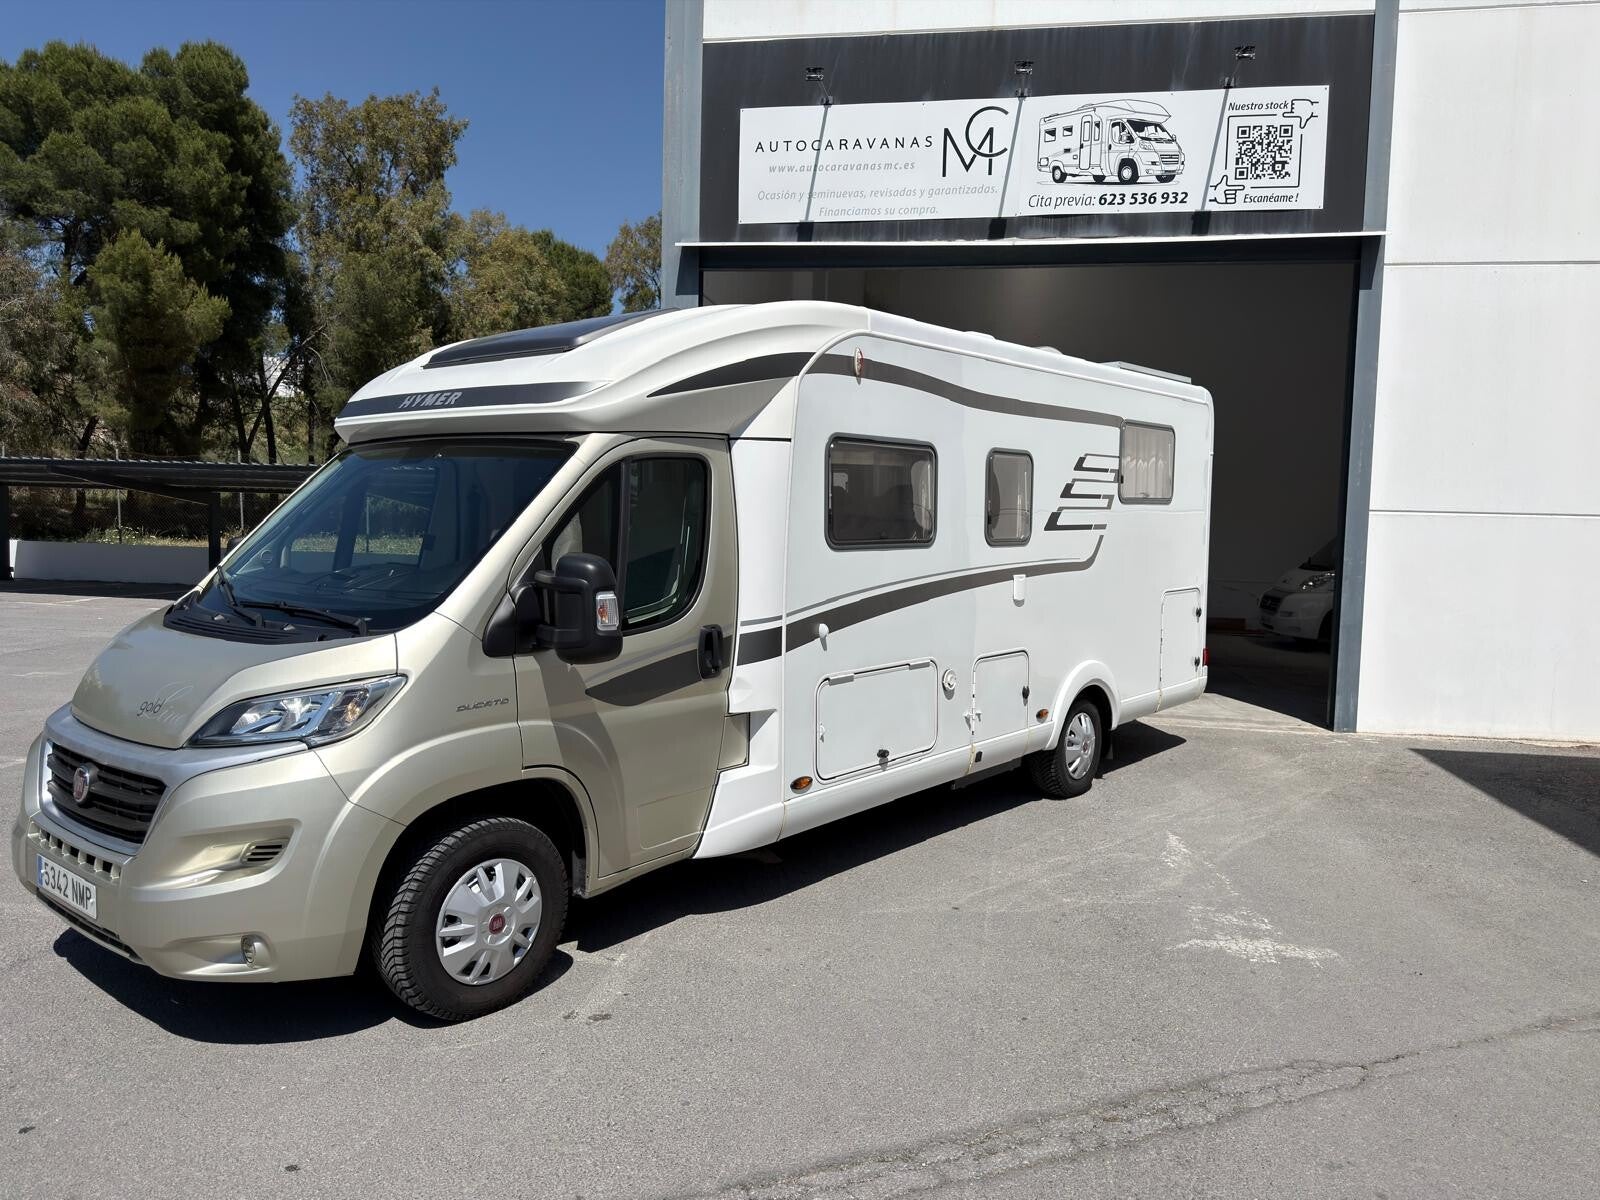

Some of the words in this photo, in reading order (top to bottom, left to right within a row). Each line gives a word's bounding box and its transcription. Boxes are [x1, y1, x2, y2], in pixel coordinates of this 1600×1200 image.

[1227, 101, 1264, 112] Nuestro
[1264, 99, 1290, 111] stock
[754, 135, 934, 153] AUTOCARAVANAS
[768, 160, 916, 174] www.auocaravanasmc.es
[757, 188, 797, 201] Ocasión
[797, 189, 805, 203] y
[869, 185, 917, 198] revisadas
[918, 187, 926, 199] y
[927, 183, 999, 199] garantizadas.
[1028, 193, 1051, 208] Cita
[1053, 192, 1097, 210] previa:
[1098, 192, 1127, 206] 623
[1129, 191, 1158, 206] 536
[1160, 190, 1190, 205] 932
[1243, 191, 1294, 204] Escanéame
[818, 205, 882, 217] Financiamos
[884, 206, 896, 216] su
[898, 204, 940, 218] compra.
[398, 390, 464, 409] HYMER
[136, 697, 167, 718] gold
[455, 697, 510, 713] DUCATO
[44, 861, 69, 899] 5342
[71, 876, 92, 911] NMP
